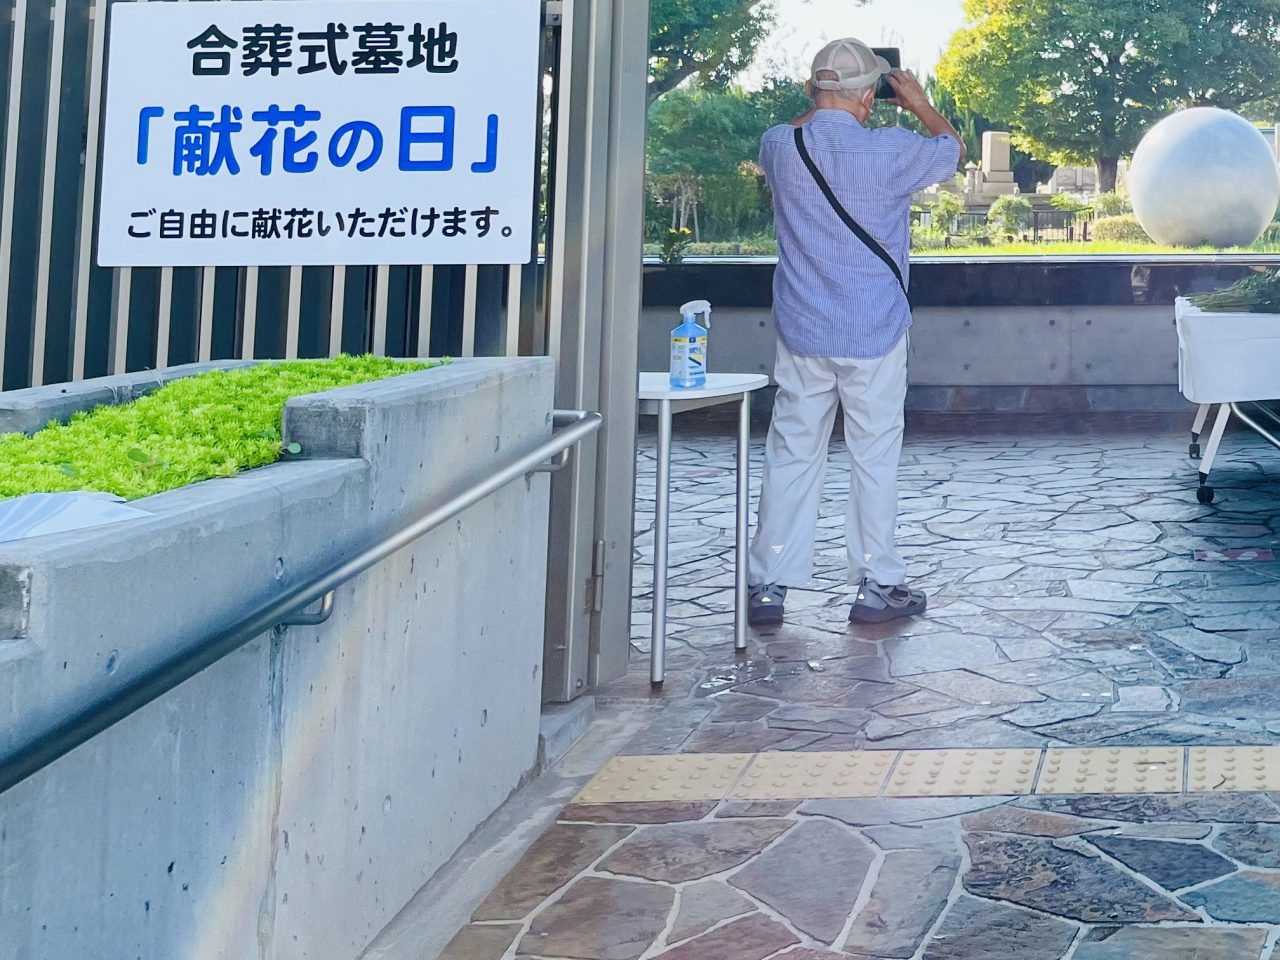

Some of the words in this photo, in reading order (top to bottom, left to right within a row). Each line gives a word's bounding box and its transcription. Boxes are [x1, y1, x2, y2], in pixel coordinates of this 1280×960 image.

[187, 22, 459, 76] 合葬式墓地
[137, 104, 499, 176] 「献花の日」
[128, 206, 513, 239] ご自由に献花いただけます。
